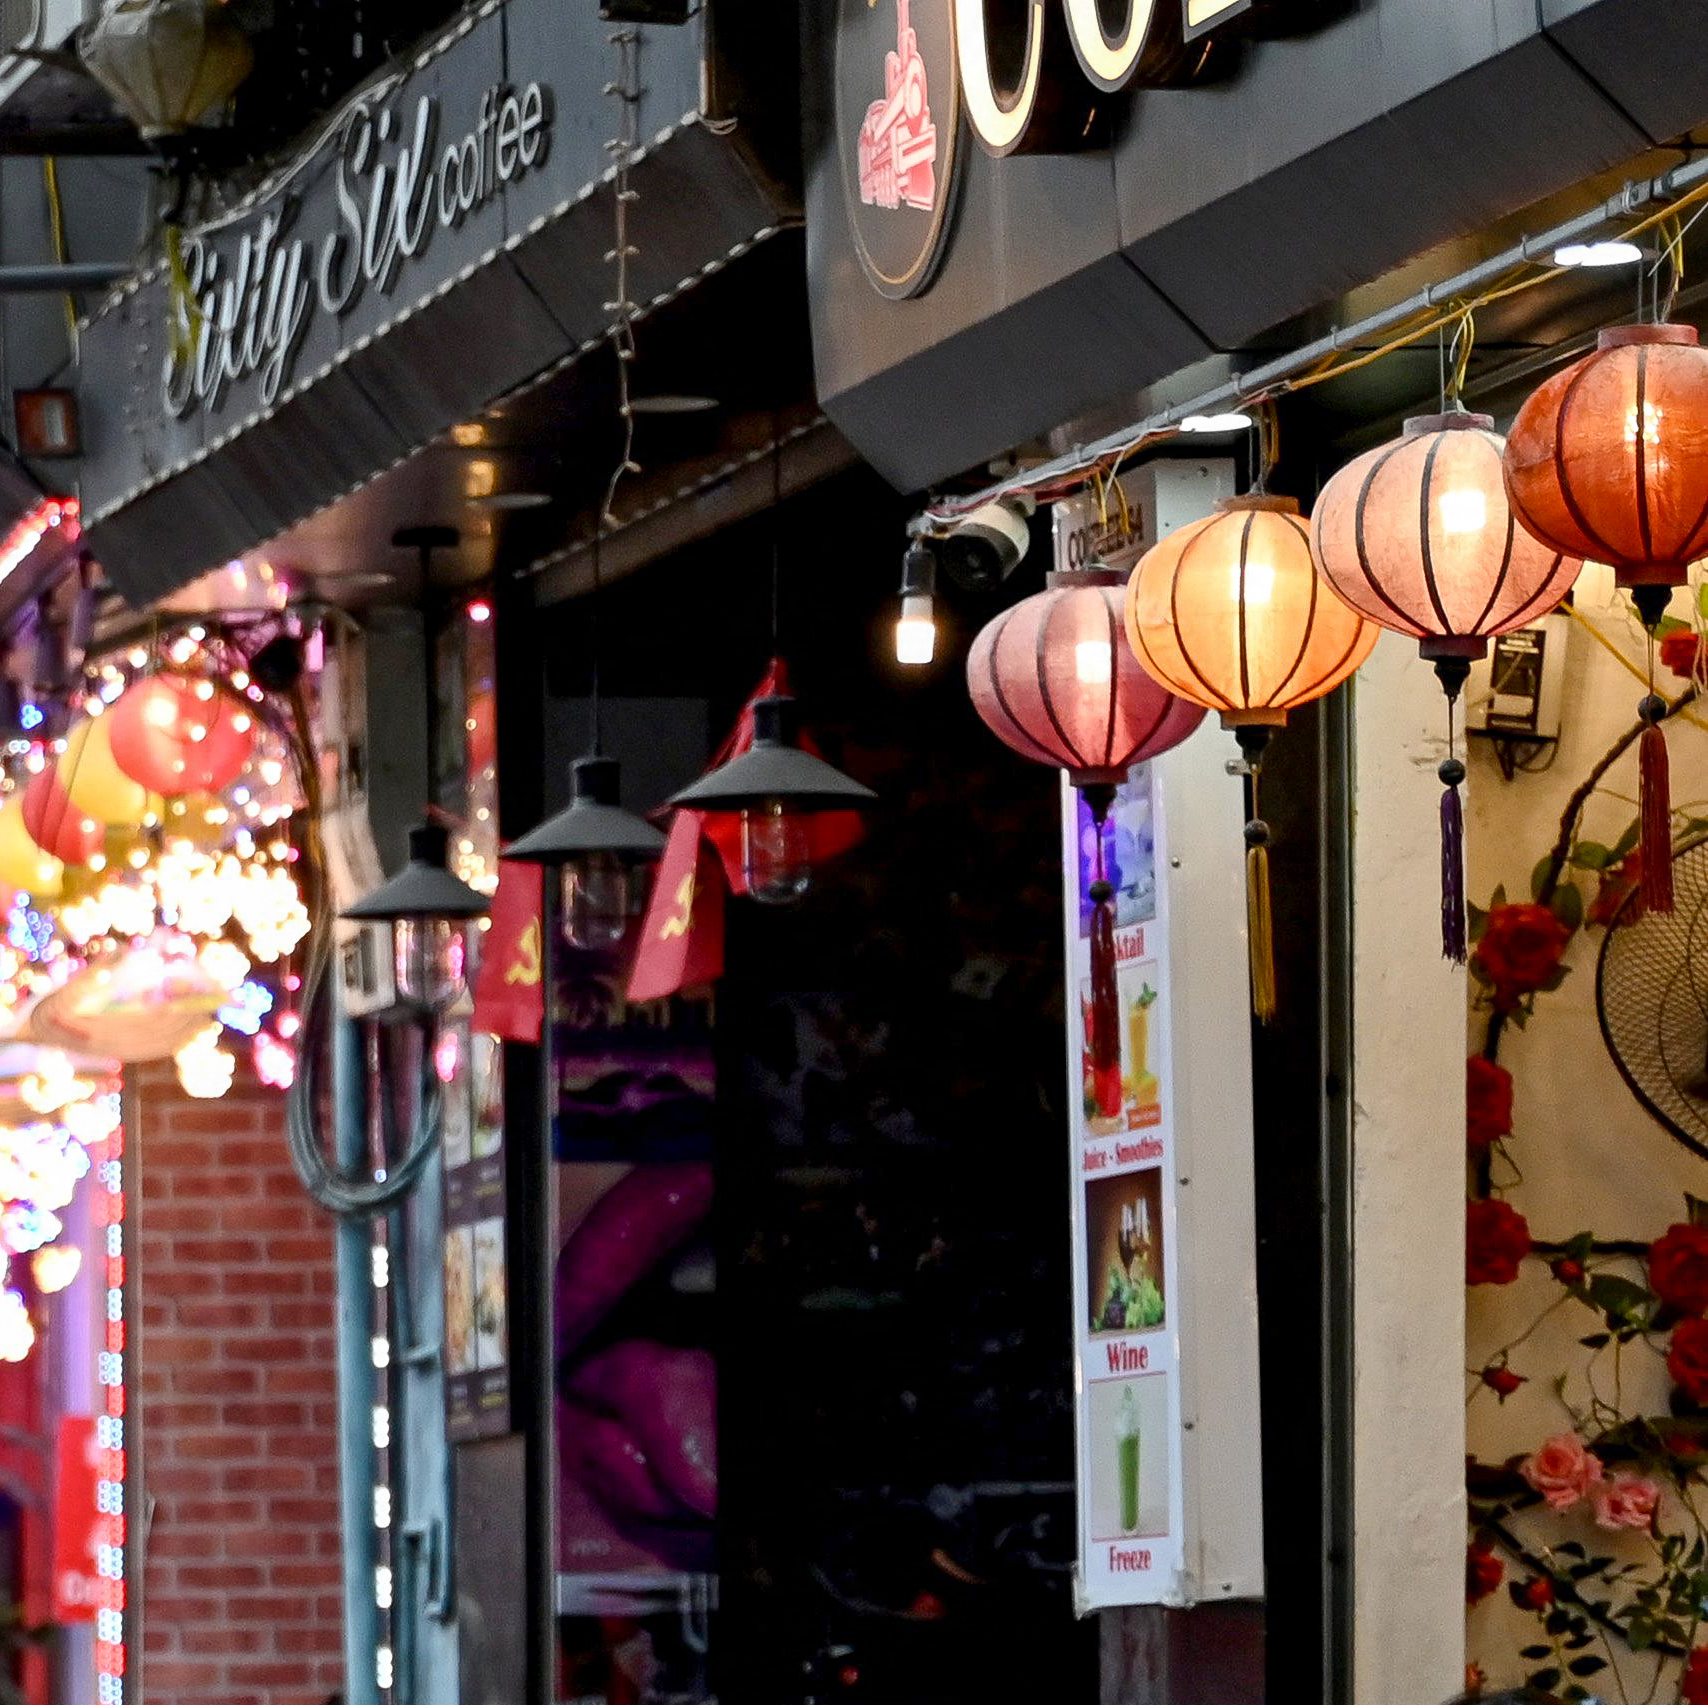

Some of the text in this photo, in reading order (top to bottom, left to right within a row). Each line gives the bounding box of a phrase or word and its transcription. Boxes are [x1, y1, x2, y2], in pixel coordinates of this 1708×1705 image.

[320, 96, 435, 316] Six
[436, 80, 545, 228] coffee
[1106, 1341, 1149, 1373] Wine
[1109, 1546, 1152, 1573] Freeze
